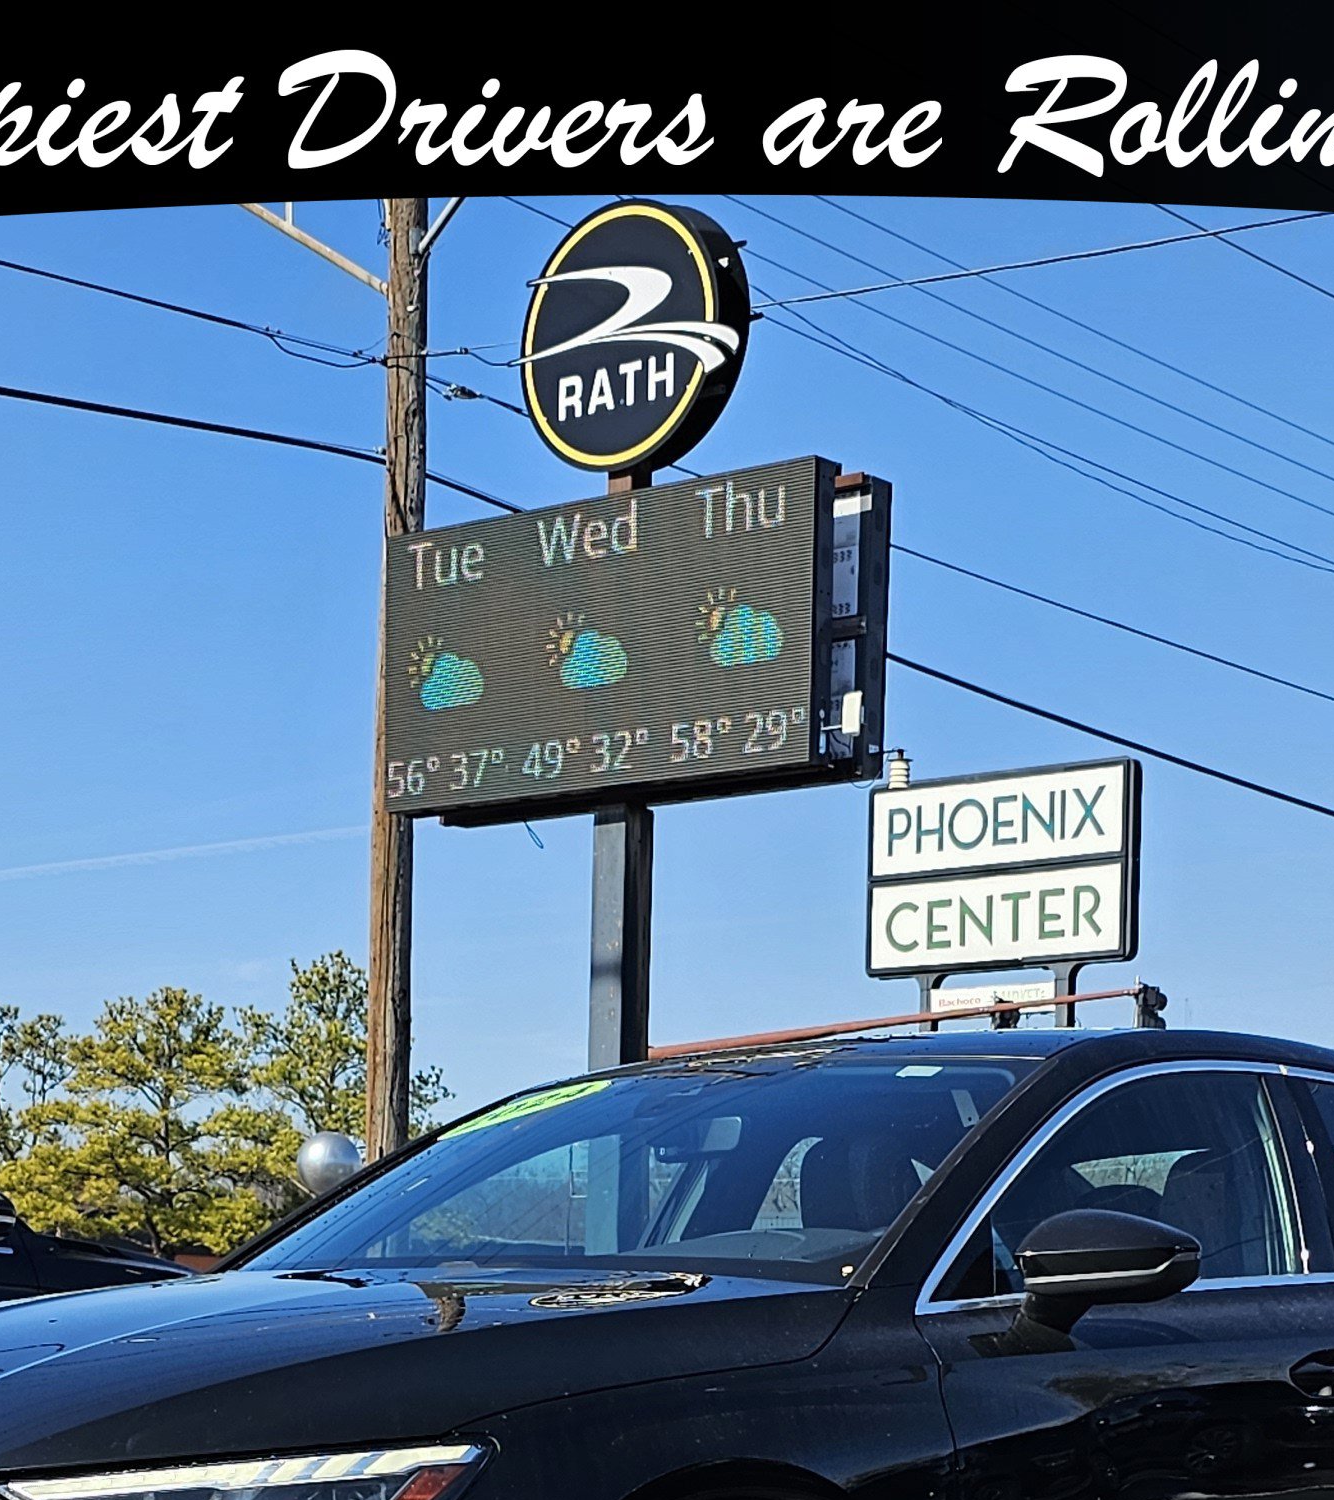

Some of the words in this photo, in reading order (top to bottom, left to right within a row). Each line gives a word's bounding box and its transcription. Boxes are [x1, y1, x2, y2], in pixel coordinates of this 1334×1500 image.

[558, 352, 675, 422] RATH
[408, 541, 485, 589] Tue
[537, 498, 639, 567] Wed
[695, 481, 786, 539] Thu
[887, 785, 1106, 857] PHOENIX
[885, 885, 1103, 953] CENTER
